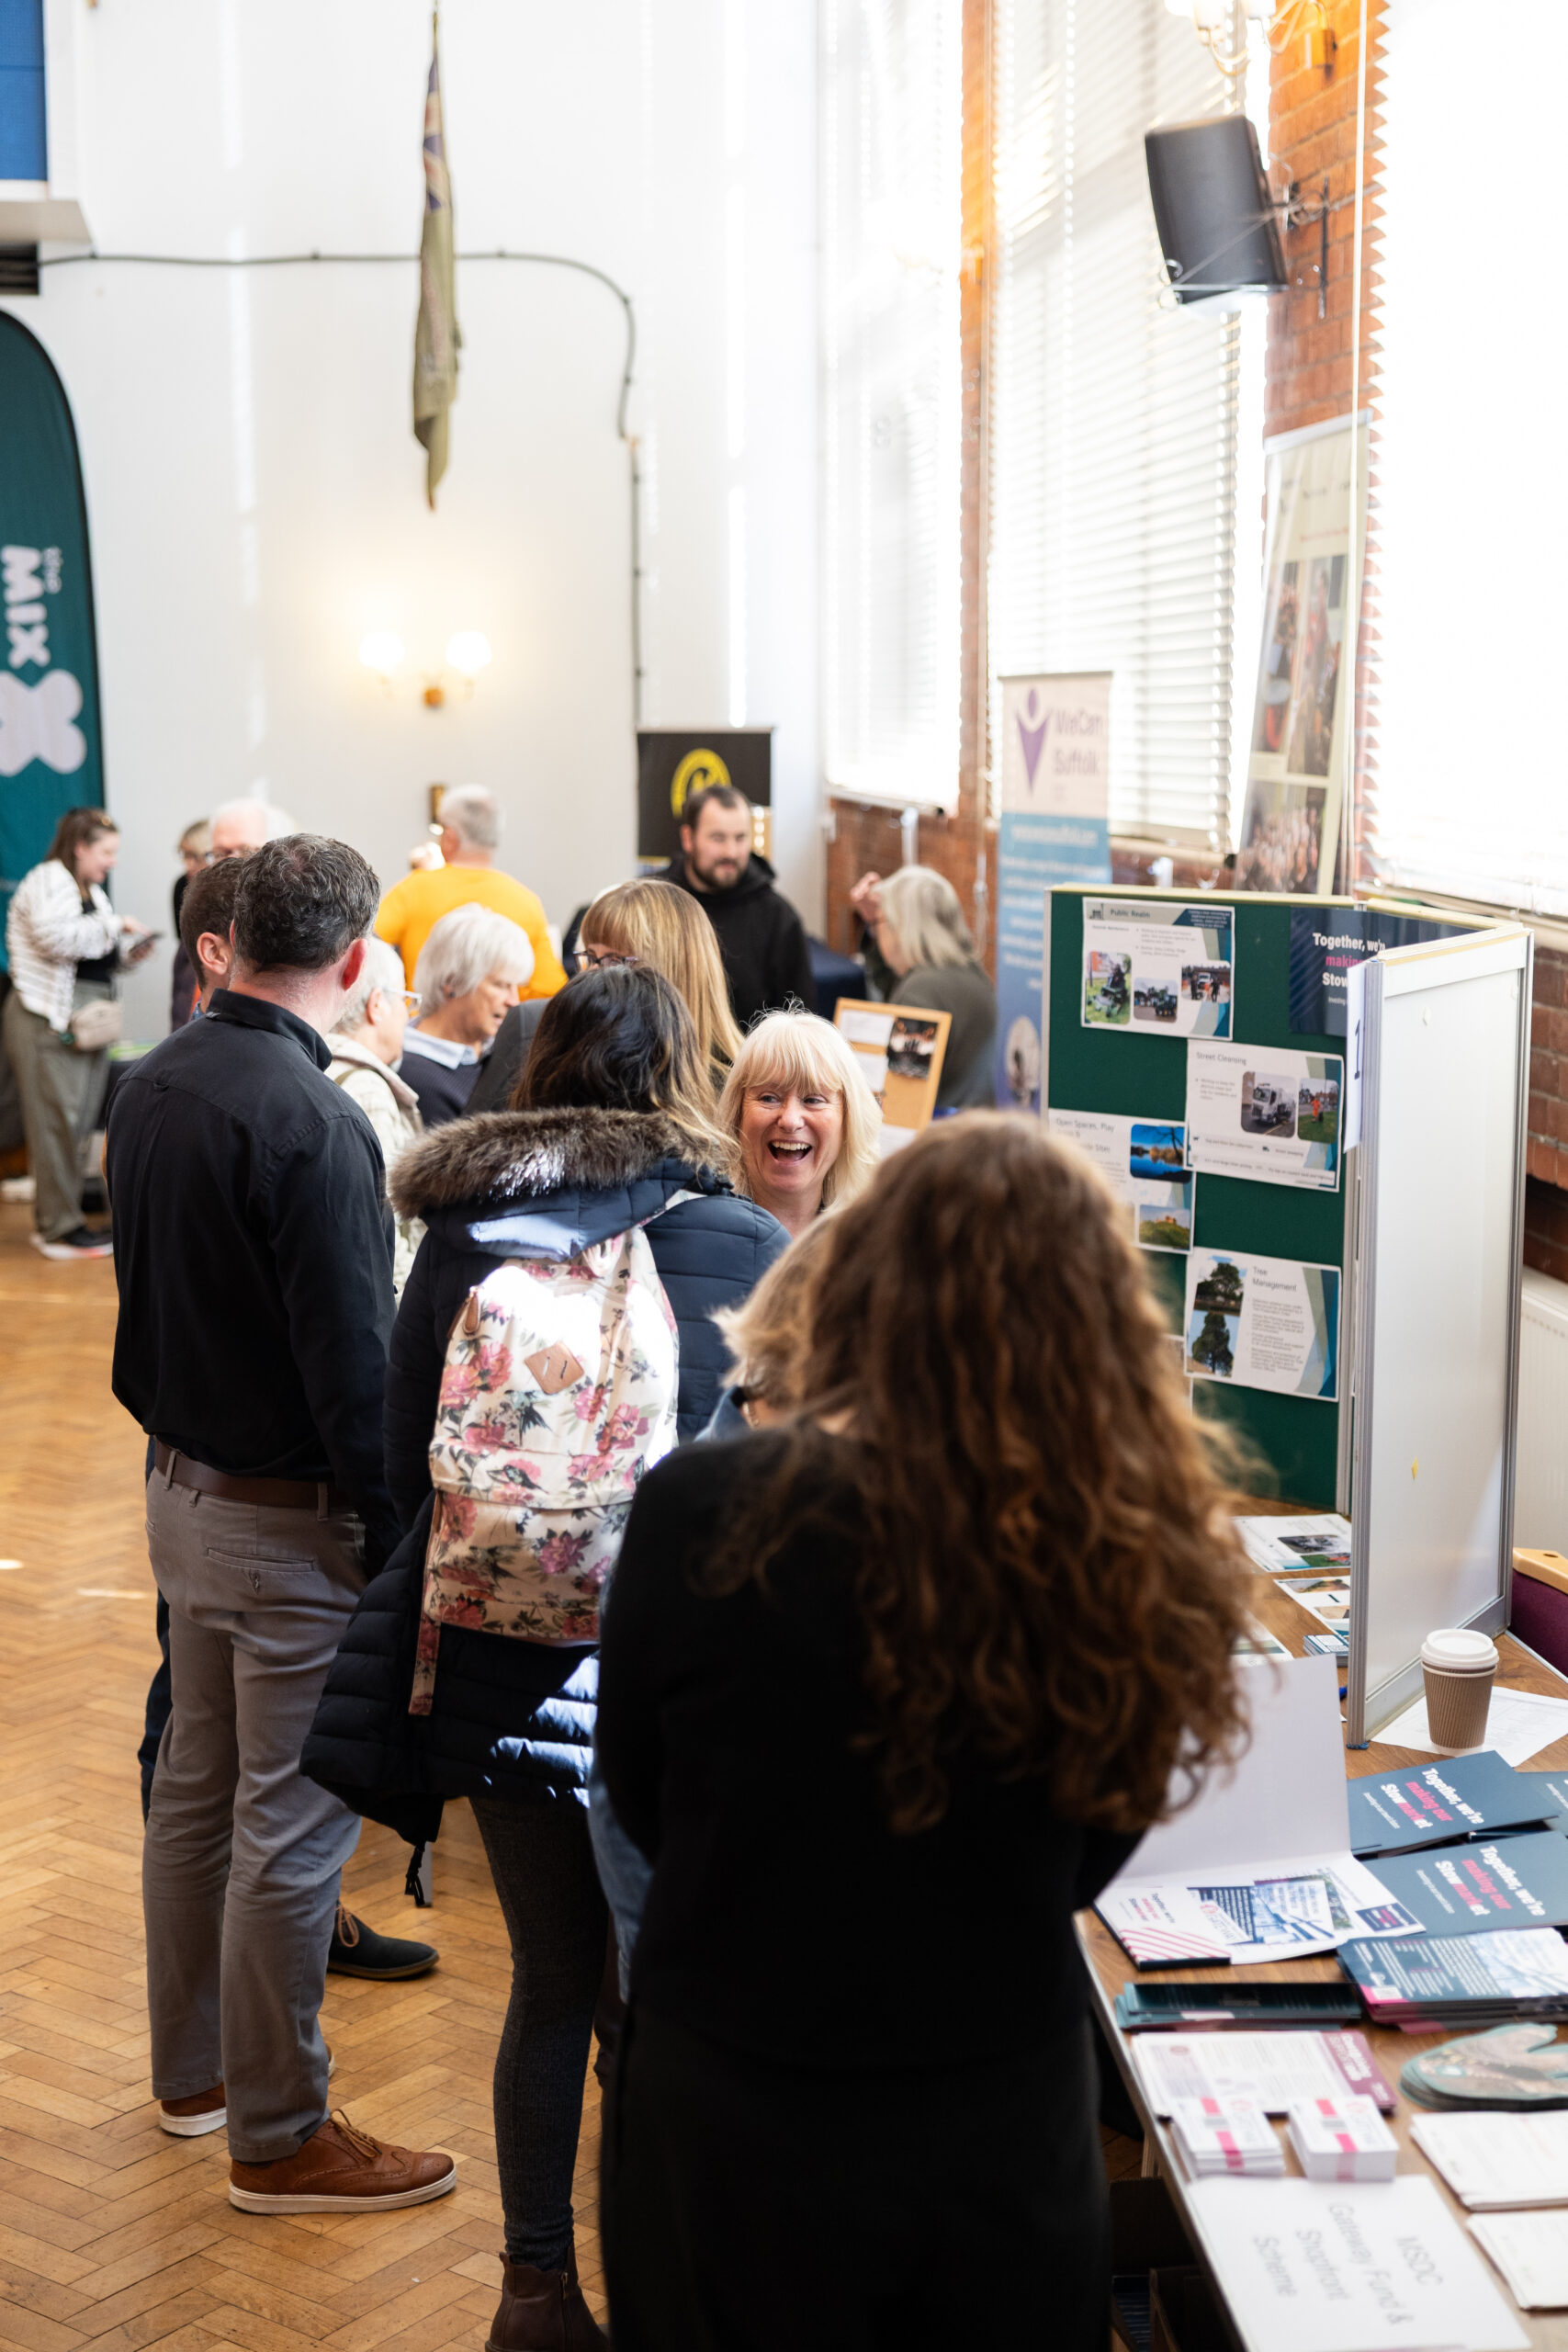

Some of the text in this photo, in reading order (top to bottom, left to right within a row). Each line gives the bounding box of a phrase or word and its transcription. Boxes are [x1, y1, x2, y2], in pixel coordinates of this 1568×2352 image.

[1054, 748, 1100, 775] Suffolk
[1110, 909, 1151, 919] Public Realm
[1312, 933, 1366, 952] Together,
[1196, 1052, 1247, 1066] Street Cleansing
[1100, 1122, 1115, 1133] Play
[1252, 1277, 1298, 1292] Management
[1253, 1265, 1267, 1275] Tree
[1380, 1783, 1434, 1829] Stowmarket
[1405, 1781, 1454, 1822] making our
[1421, 1768, 1485, 1825] Together, we're
[1434, 1860, 1491, 1917] Stowmarket
[1461, 1859, 1512, 1910] making our
[1480, 1845, 1546, 1917] Together, we're
[1252, 2235, 1299, 2298] Scheme
[1295, 2228, 1353, 2301] Shopfront
[1328, 2204, 1377, 2267] Gateway
[1363, 2267, 1406, 2310] Fund
[1393, 2234, 1445, 2286] MSDC
